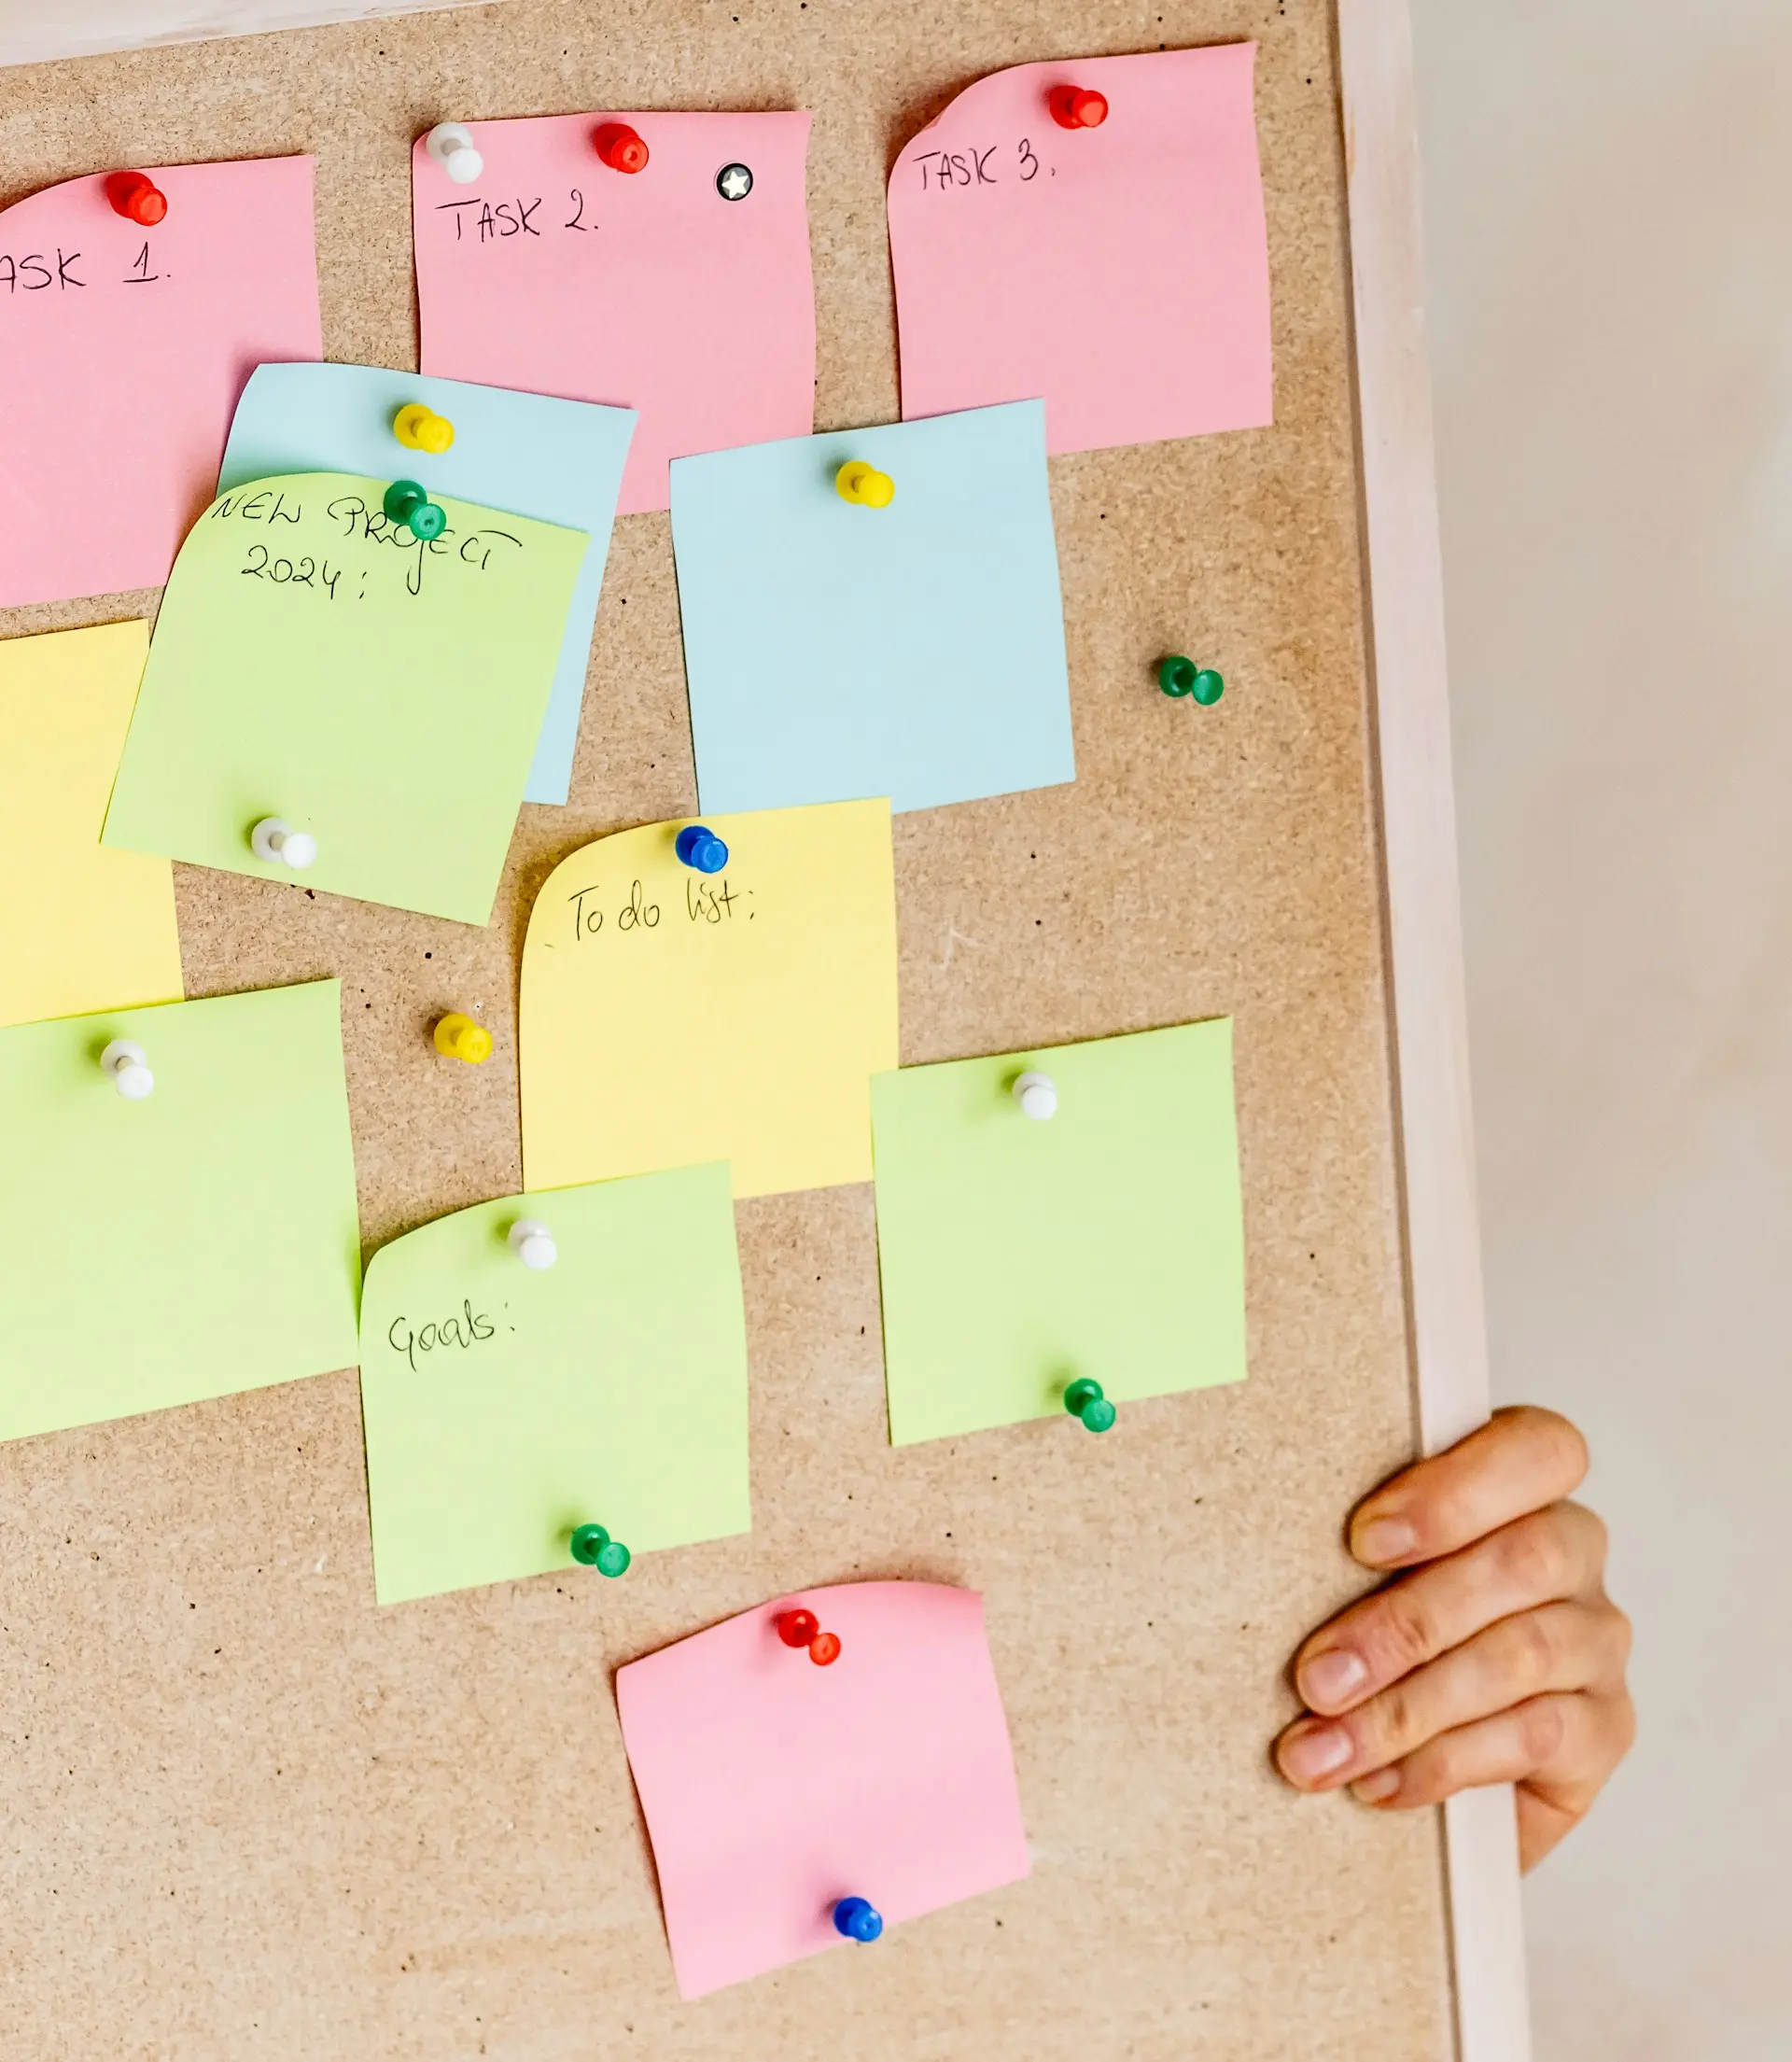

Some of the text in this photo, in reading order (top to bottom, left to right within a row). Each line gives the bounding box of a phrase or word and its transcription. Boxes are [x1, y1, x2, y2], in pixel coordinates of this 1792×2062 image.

[911, 145, 997, 190] TASK
[433, 189, 599, 243] TASK 2.
[122, 241, 172, 283] 1.
[211, 491, 523, 596] NEW PROJECT
[567, 885, 603, 942] To
[618, 879, 661, 932] do
[388, 1298, 515, 1372] Goals:
